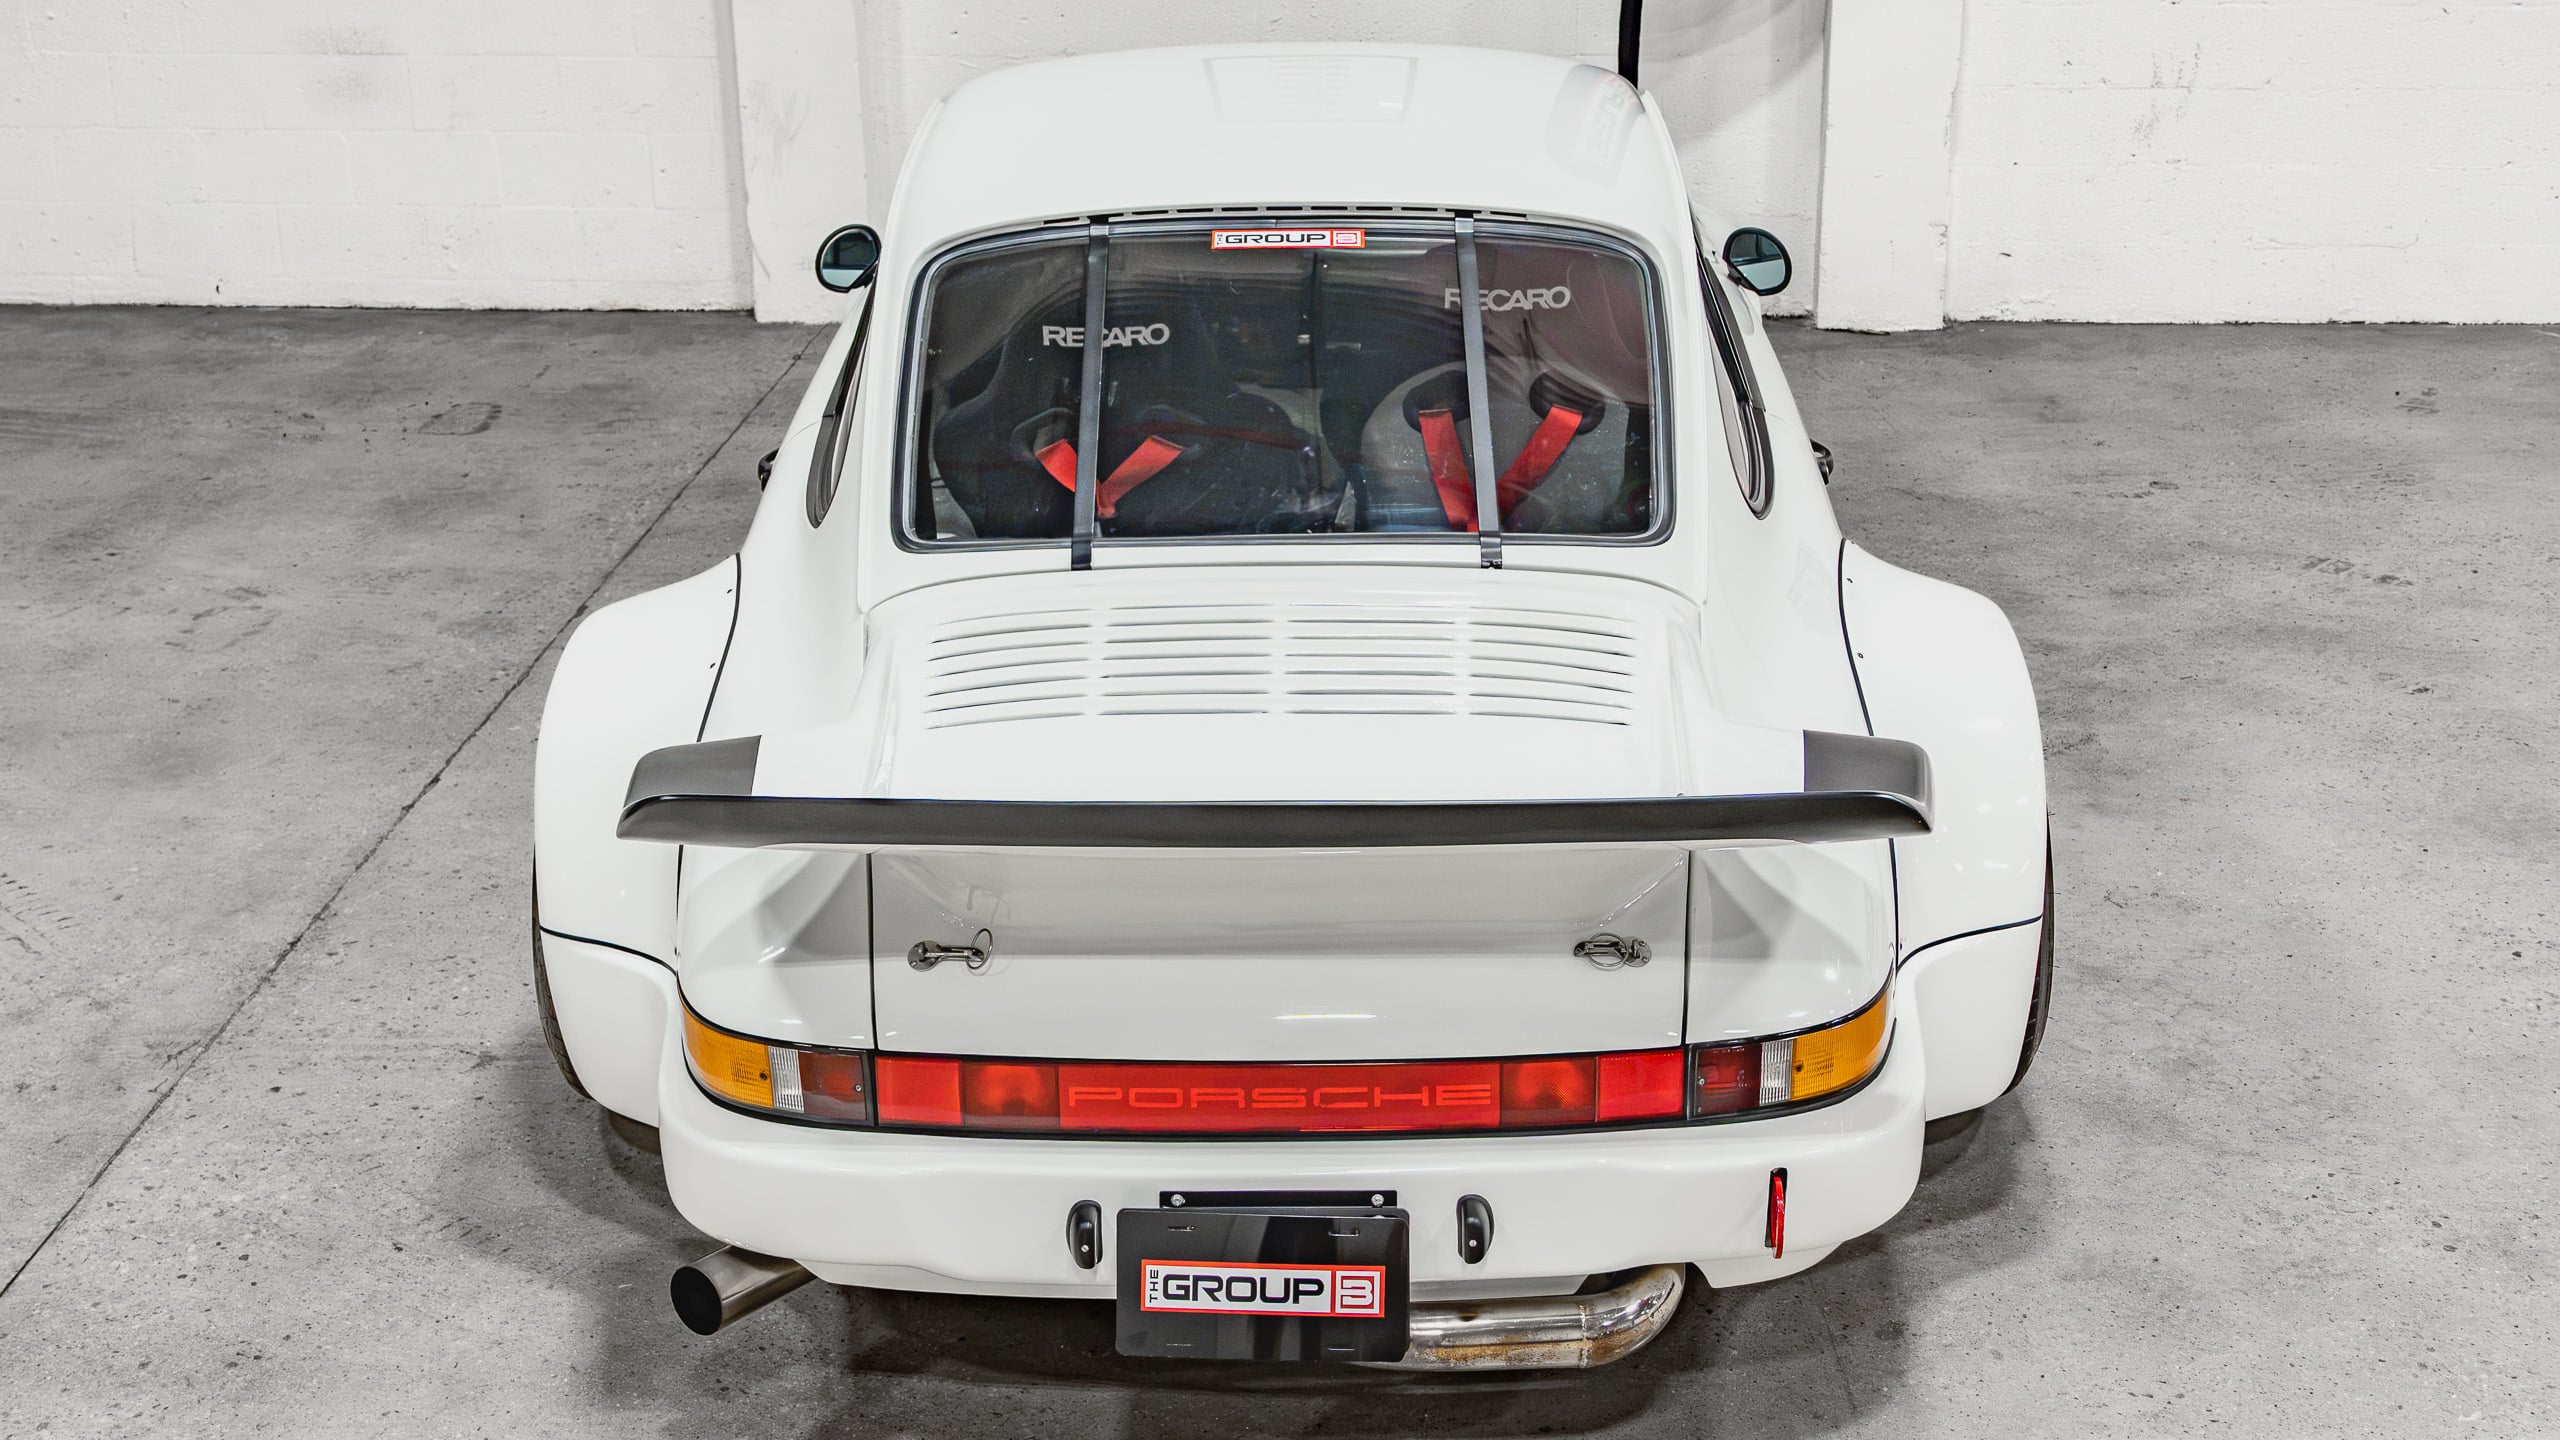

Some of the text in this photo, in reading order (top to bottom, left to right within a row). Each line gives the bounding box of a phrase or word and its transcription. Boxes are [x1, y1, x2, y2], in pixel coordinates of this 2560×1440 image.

[1225, 233, 1326, 244] GROUP
[1068, 1084, 1491, 1109] PORSCHE
[1149, 1269, 1159, 1304] THE
[1162, 1273, 1325, 1305] GROUP
